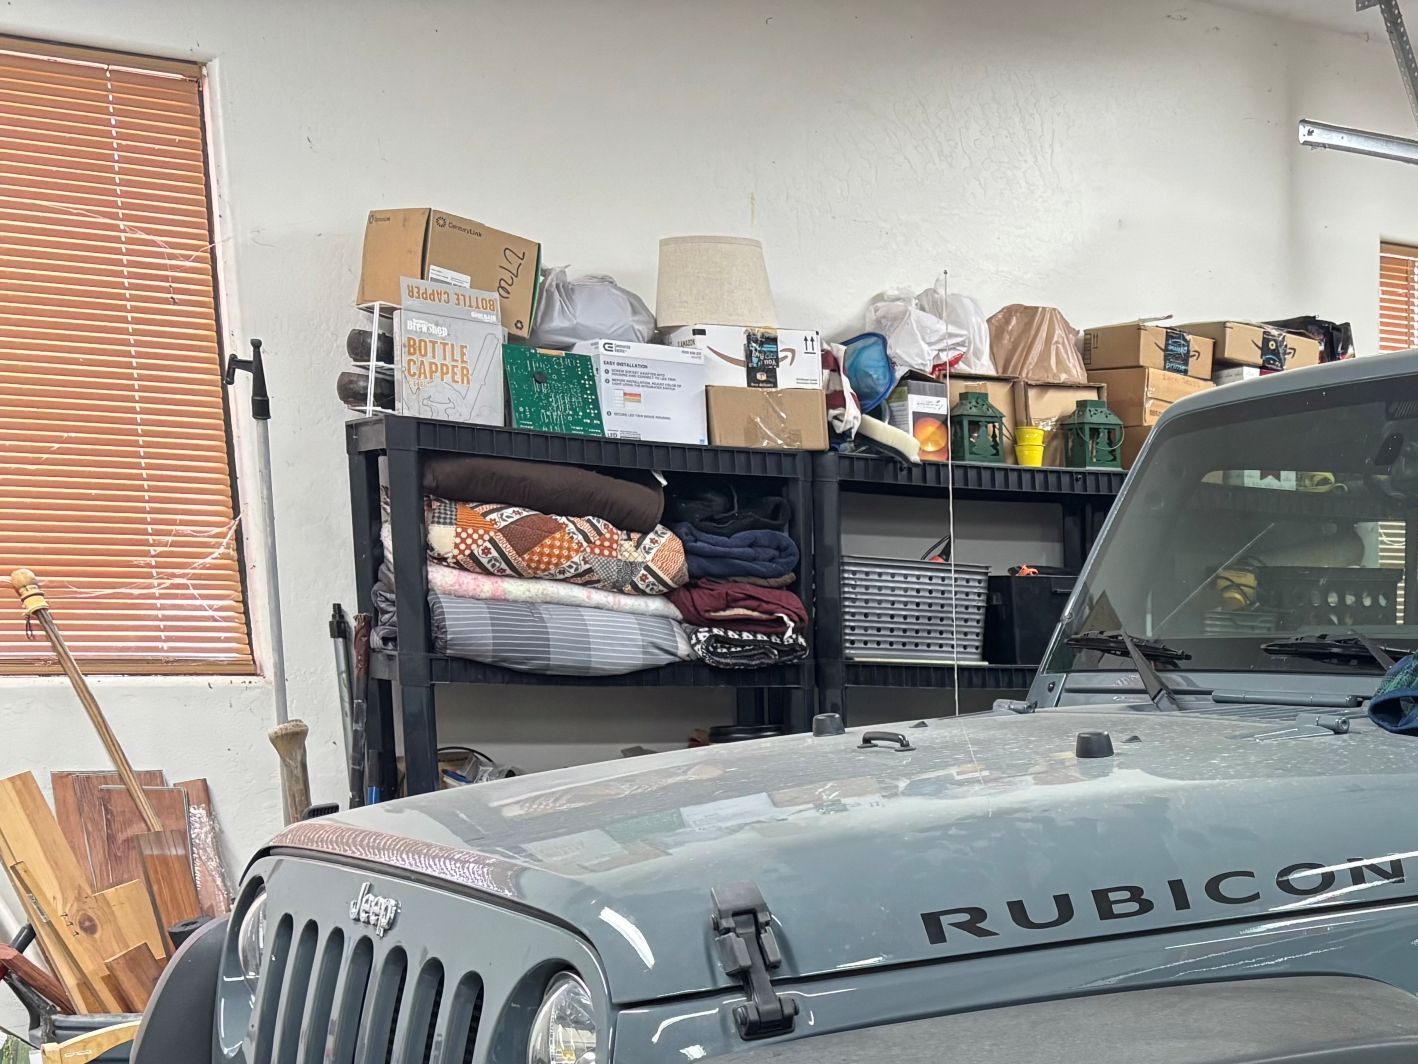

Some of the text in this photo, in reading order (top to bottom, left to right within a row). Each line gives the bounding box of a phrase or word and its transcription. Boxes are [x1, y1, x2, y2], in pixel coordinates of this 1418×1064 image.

[448, 222, 482, 238] CenturyLink
[407, 284, 497, 312] BOTTLE CAPPER
[406, 336, 469, 364] BOTTLE
[406, 358, 471, 385] CAPPER
[1166, 361, 1188, 372] prime
[349, 881, 397, 937] Jeep
[920, 857, 1406, 945] RUBICON
